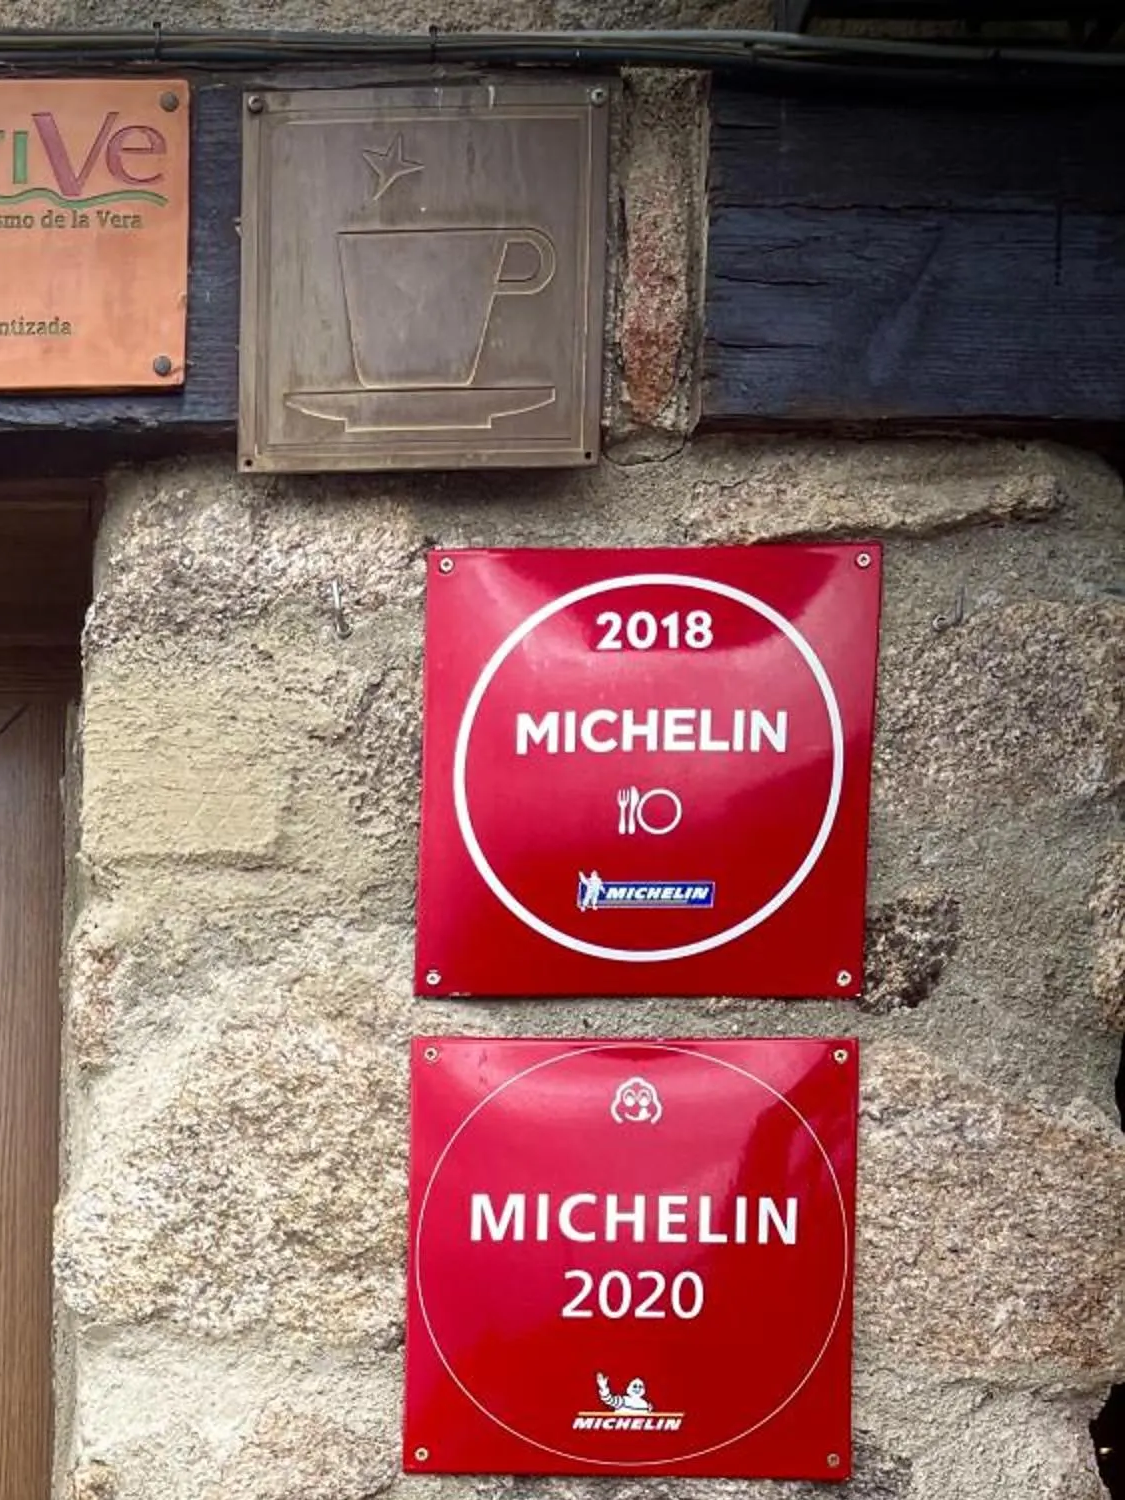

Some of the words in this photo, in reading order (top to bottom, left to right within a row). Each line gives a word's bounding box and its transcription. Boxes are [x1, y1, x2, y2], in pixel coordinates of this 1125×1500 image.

[41, 210, 66, 229] de
[73, 210, 91, 229] la
[97, 211, 143, 229] Vera
[596, 610, 714, 650] 2018
[515, 709, 788, 755] MICHELIN
[605, 886, 709, 900] MICHELIN
[470, 1193, 797, 1245] MICHELIN
[562, 1270, 704, 1319] 2020
[572, 1416, 683, 1431] MICHELIN
